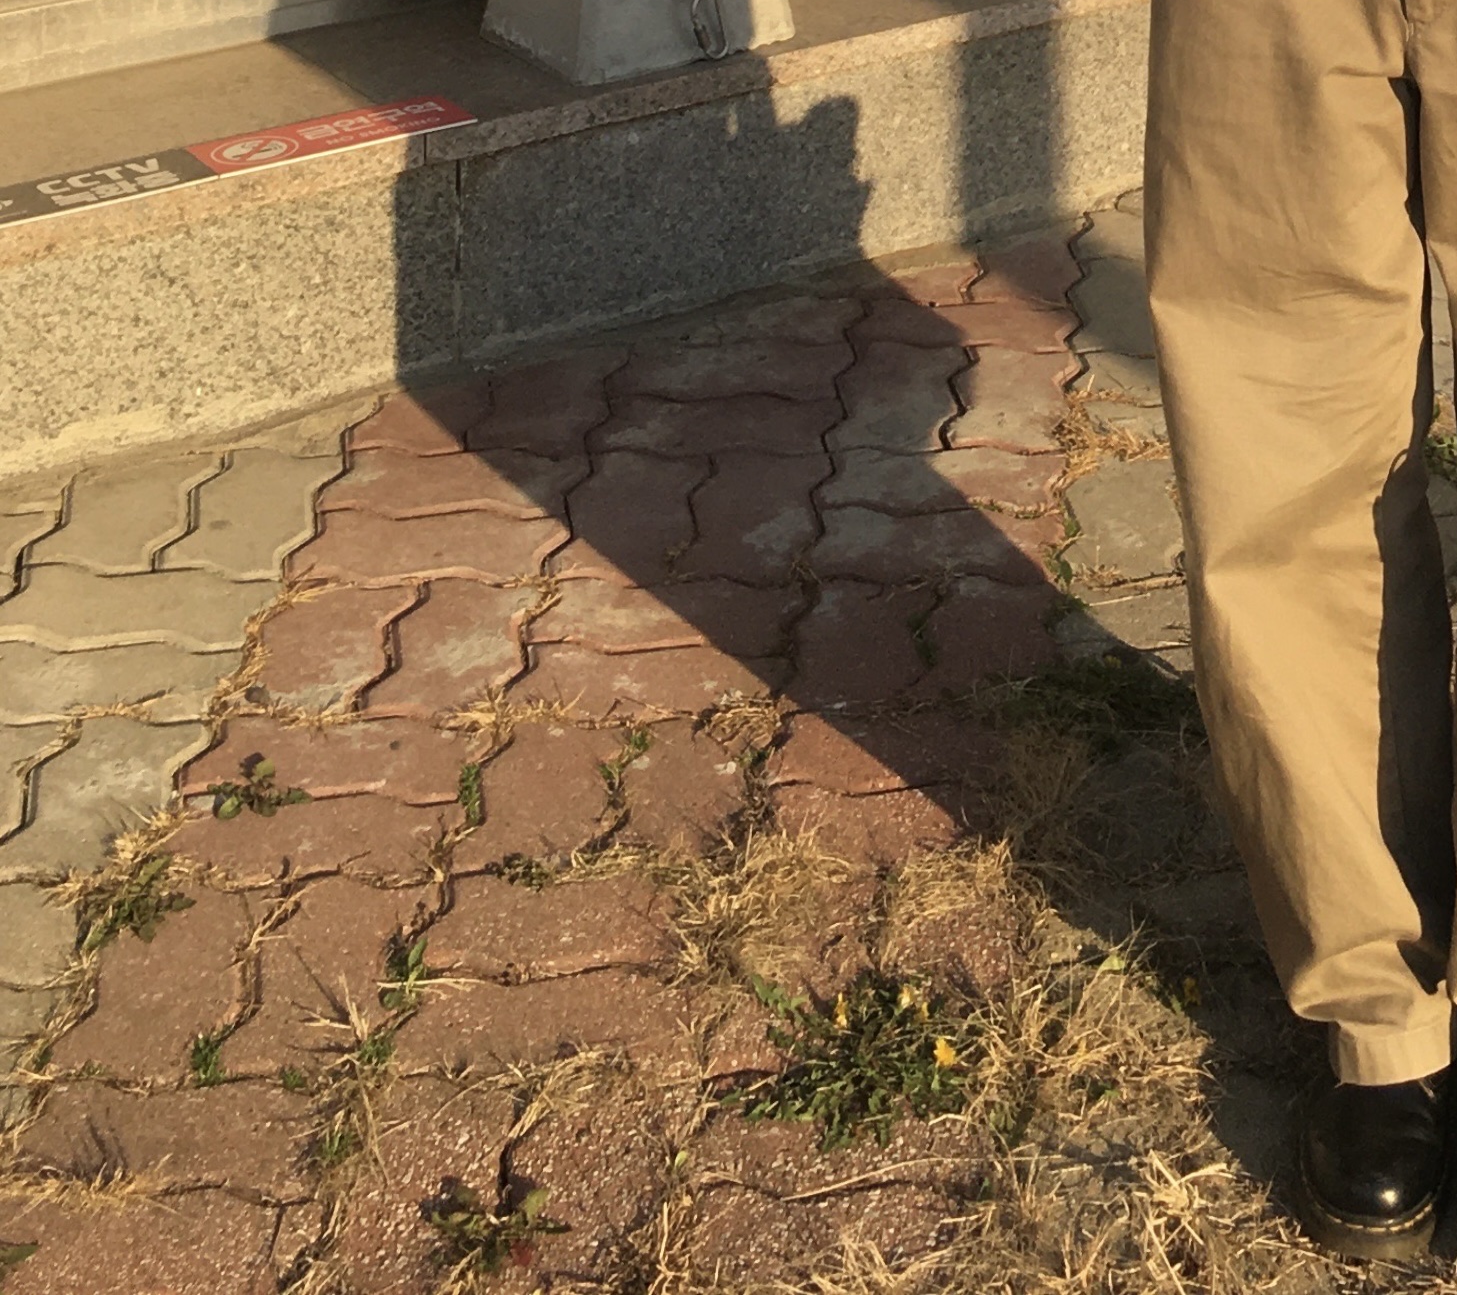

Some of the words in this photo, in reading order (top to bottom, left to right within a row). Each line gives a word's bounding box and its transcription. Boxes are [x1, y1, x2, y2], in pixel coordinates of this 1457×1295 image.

[296, 101, 445, 141] 금연구역
[326, 134, 355, 146] NO
[358, 116, 441, 139] SMOKING
[36, 157, 160, 195] CCTV
